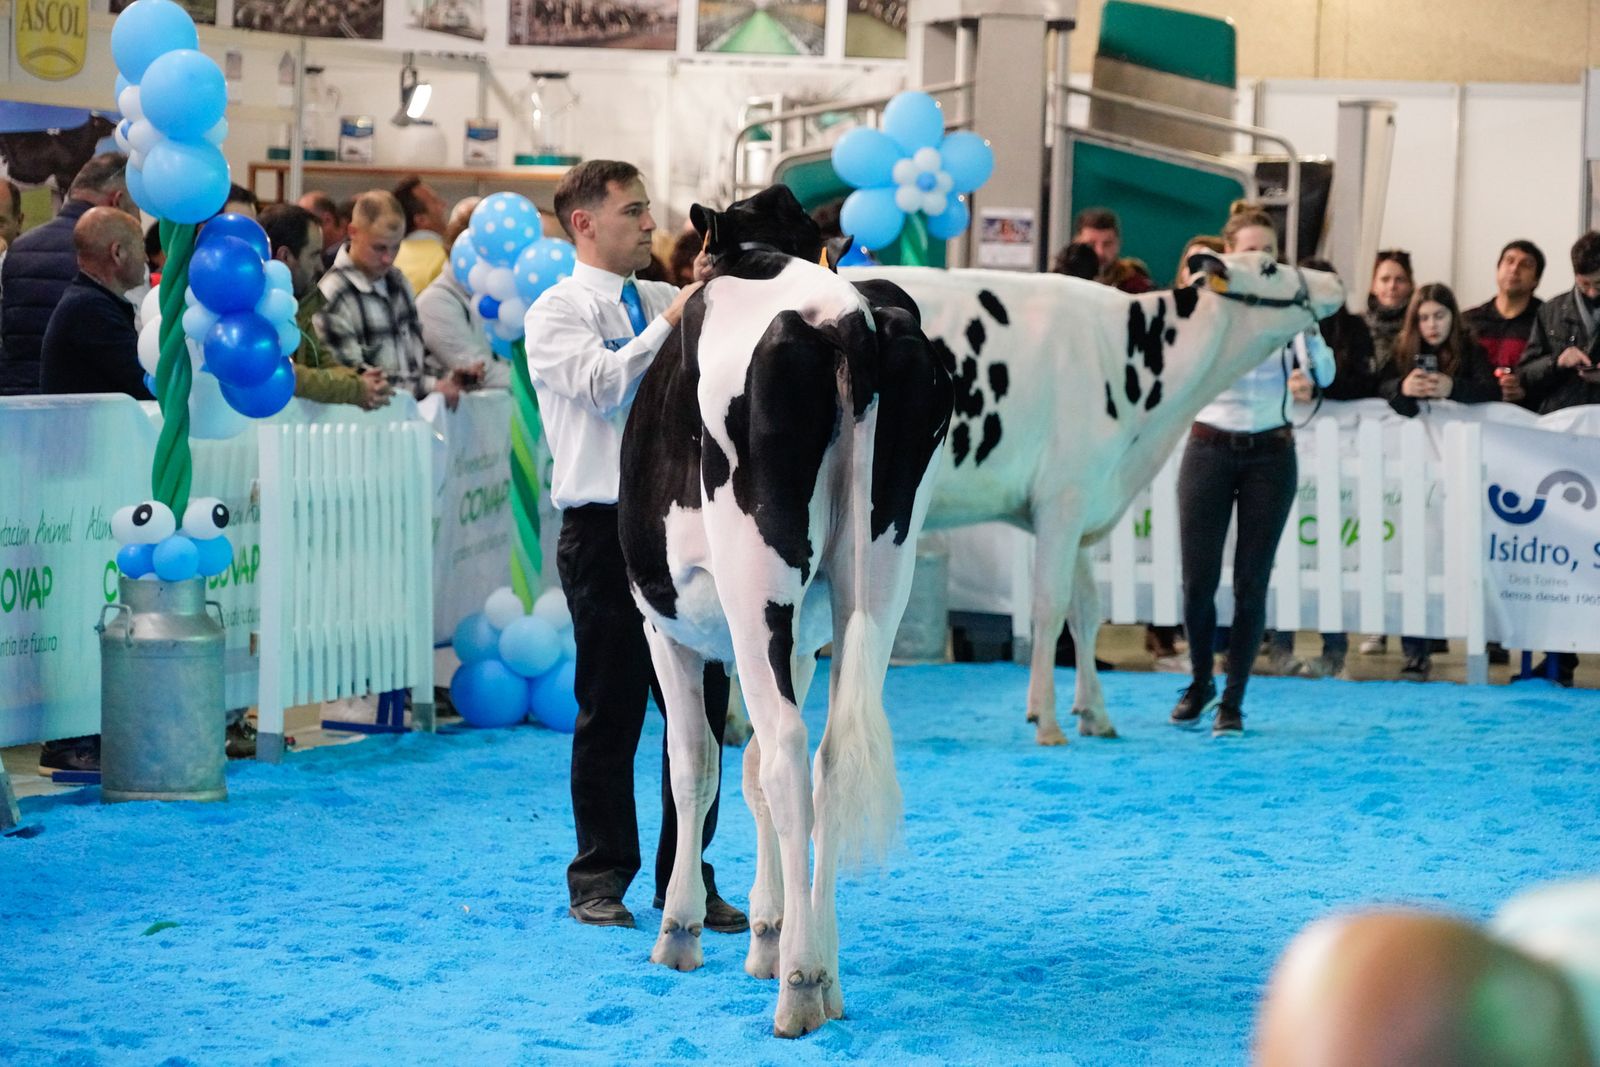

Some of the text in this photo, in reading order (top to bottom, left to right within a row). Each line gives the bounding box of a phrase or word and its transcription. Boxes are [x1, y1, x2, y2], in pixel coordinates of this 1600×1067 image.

[20, 0, 84, 38] ASCOL
[35, 508, 74, 544] Animal
[1490, 533, 1579, 572] Isidro,
[0, 566, 53, 613] OVAP
